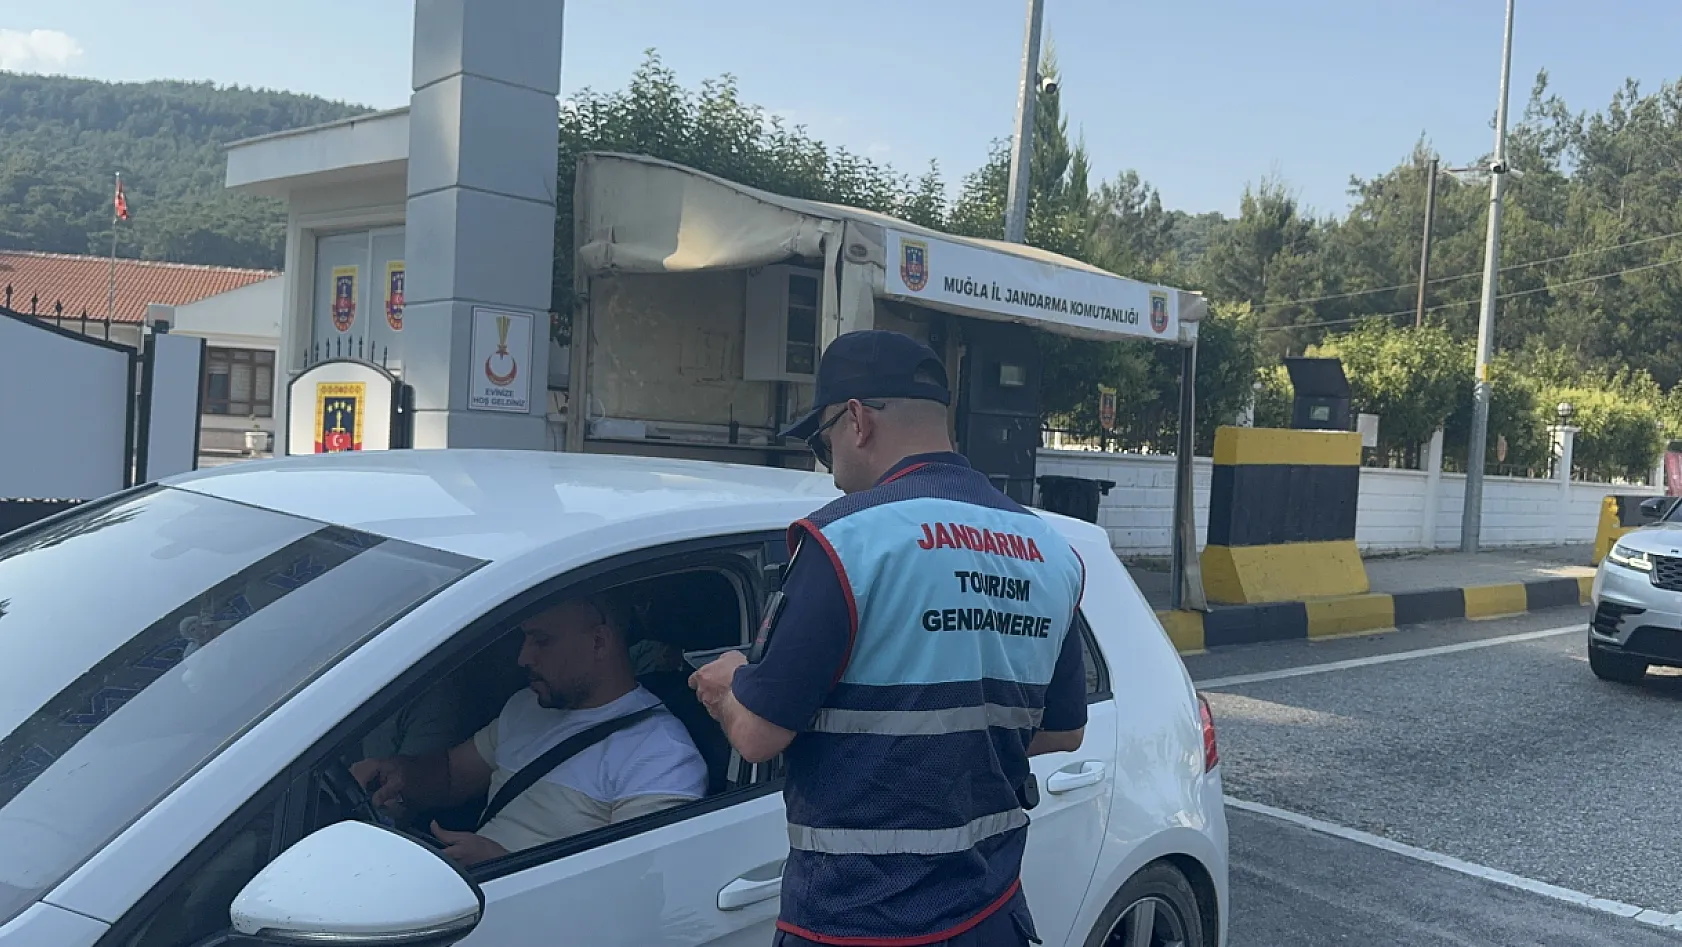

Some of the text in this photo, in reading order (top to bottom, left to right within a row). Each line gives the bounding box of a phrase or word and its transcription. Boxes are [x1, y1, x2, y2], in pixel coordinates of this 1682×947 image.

[944, 276, 988, 299] MUĞLA
[991, 282, 1001, 301] İL
[1004, 288, 1067, 312] JANDARMA
[1069, 300, 1139, 325] KOMUTANLIĞI
[917, 522, 1044, 563] JANDARMA
[922, 608, 1051, 639] GENDAMERIE
